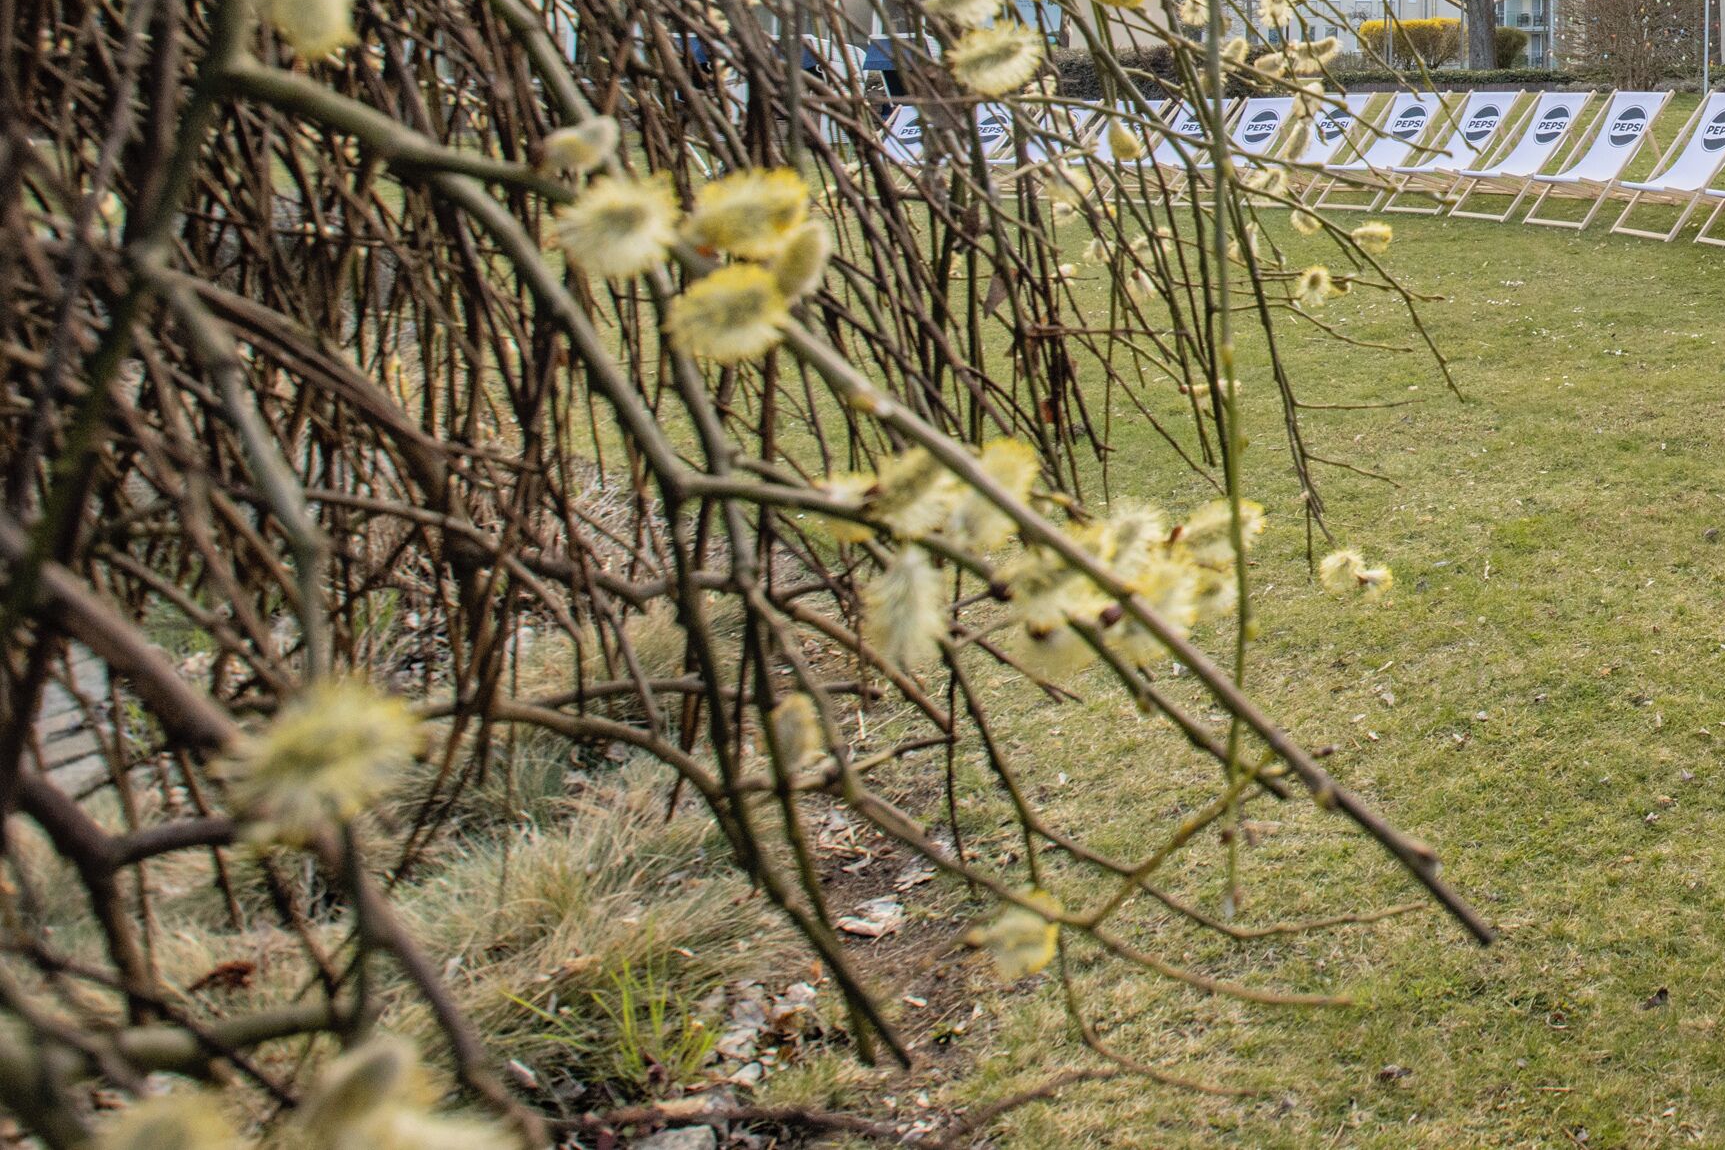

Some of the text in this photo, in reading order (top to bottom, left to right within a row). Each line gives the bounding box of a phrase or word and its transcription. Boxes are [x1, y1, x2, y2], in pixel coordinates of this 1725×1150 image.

[1246, 123, 1276, 131] PEPSI
[1395, 120, 1424, 128] PEPSI
[1468, 120, 1497, 128] PEPSI
[1538, 121, 1567, 130] PEPSI
[1612, 122, 1644, 132] PEPSI
